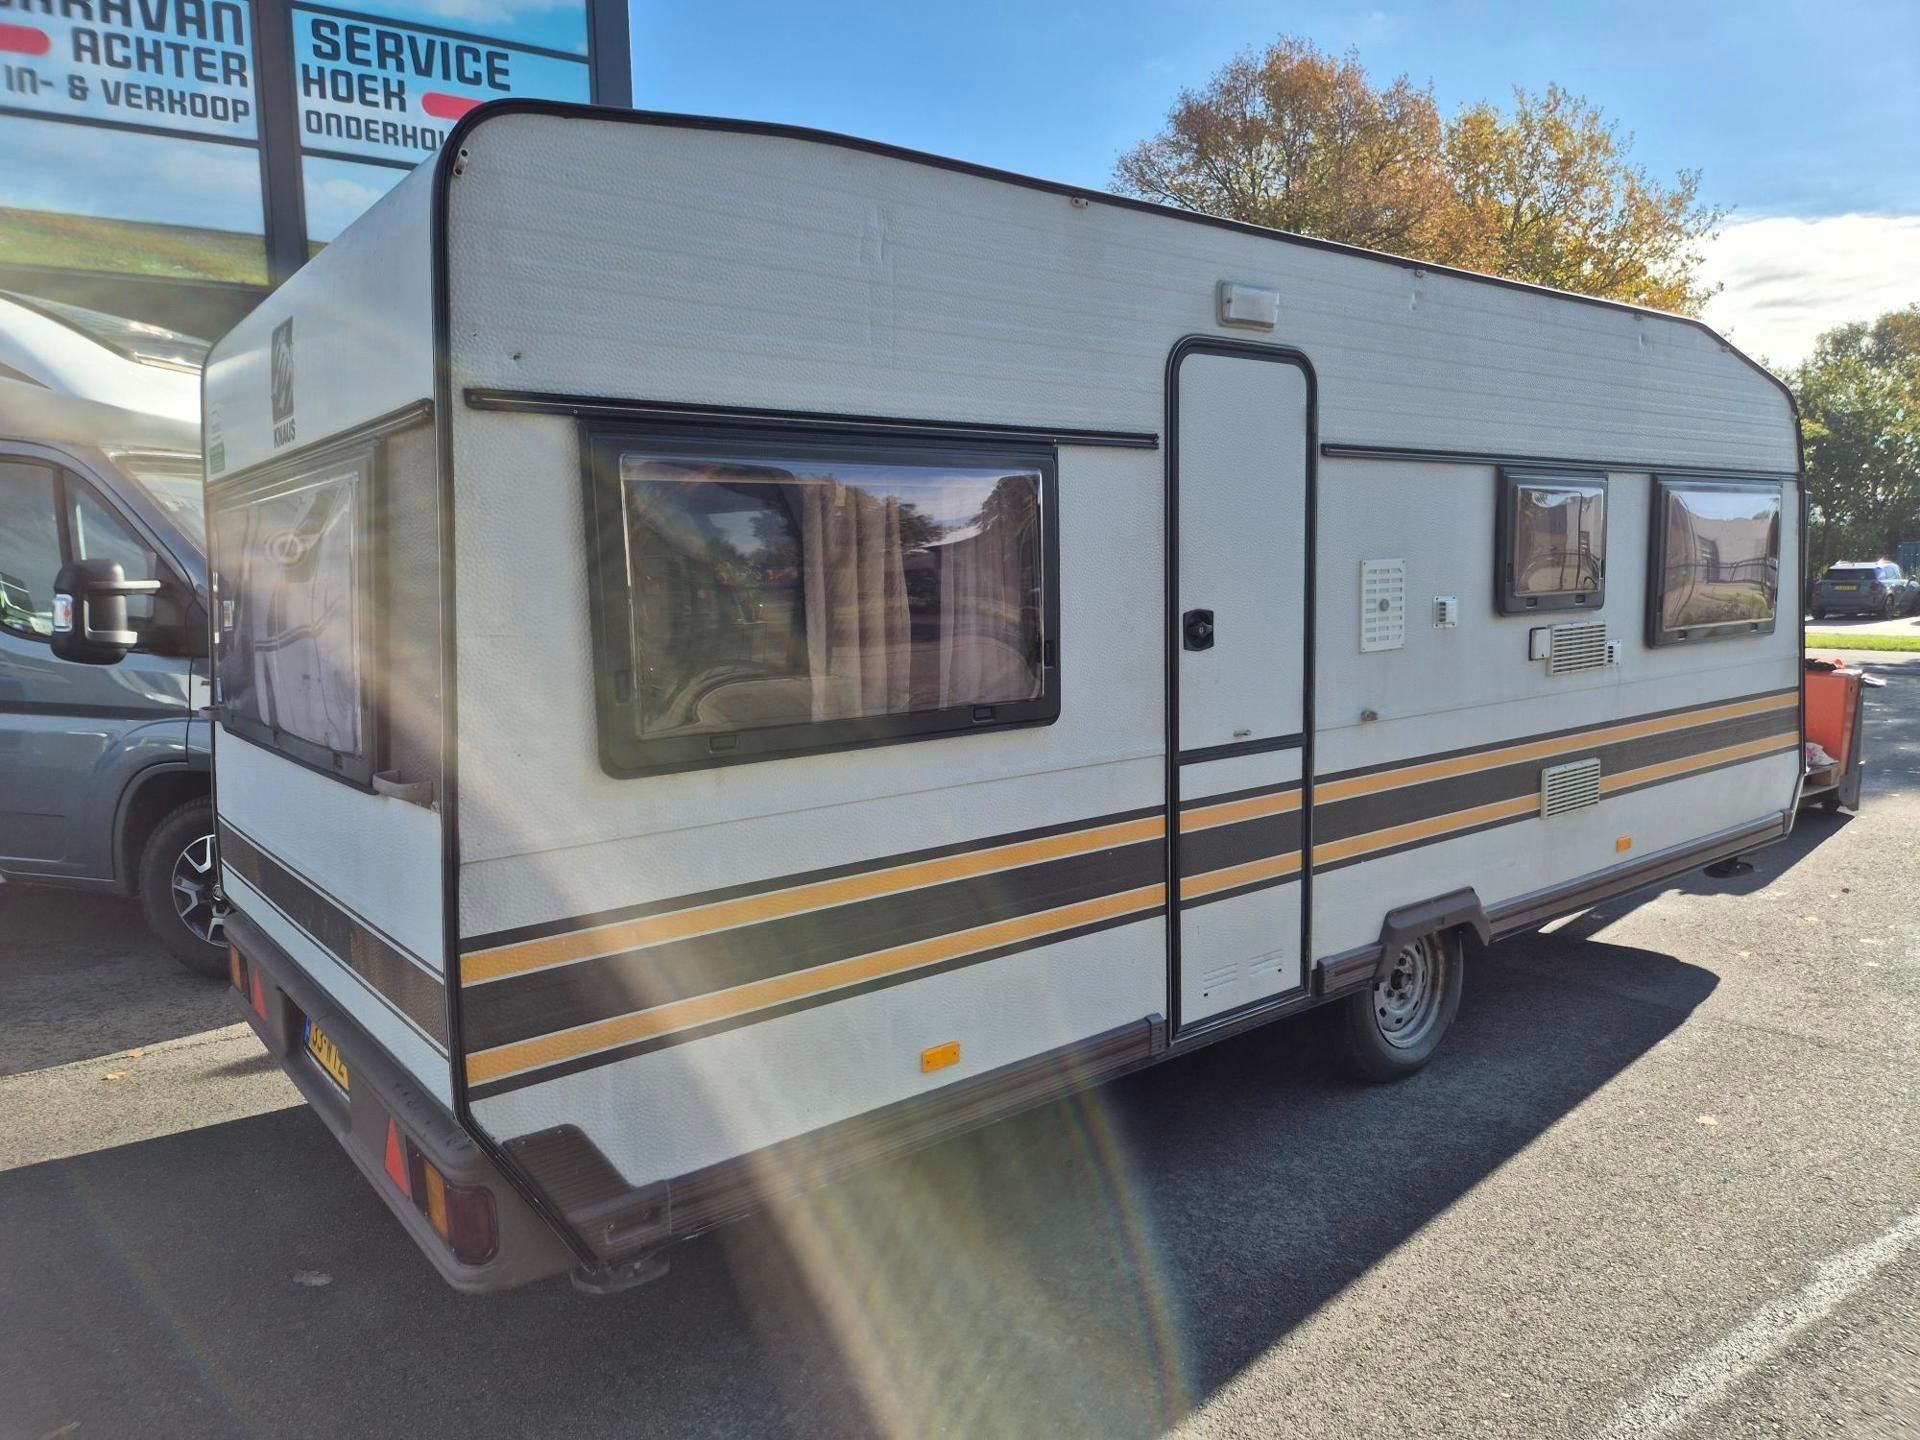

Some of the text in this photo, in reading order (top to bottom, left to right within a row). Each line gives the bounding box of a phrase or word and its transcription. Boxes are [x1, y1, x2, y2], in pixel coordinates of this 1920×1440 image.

[0, 0, 245, 46] AVAN
[72, 26, 248, 88] ACHTER
[311, 18, 511, 92] SERVICE
[67, 74, 89, 101] &
[101, 79, 250, 123] VERKOOP
[302, 63, 407, 113] HOEK
